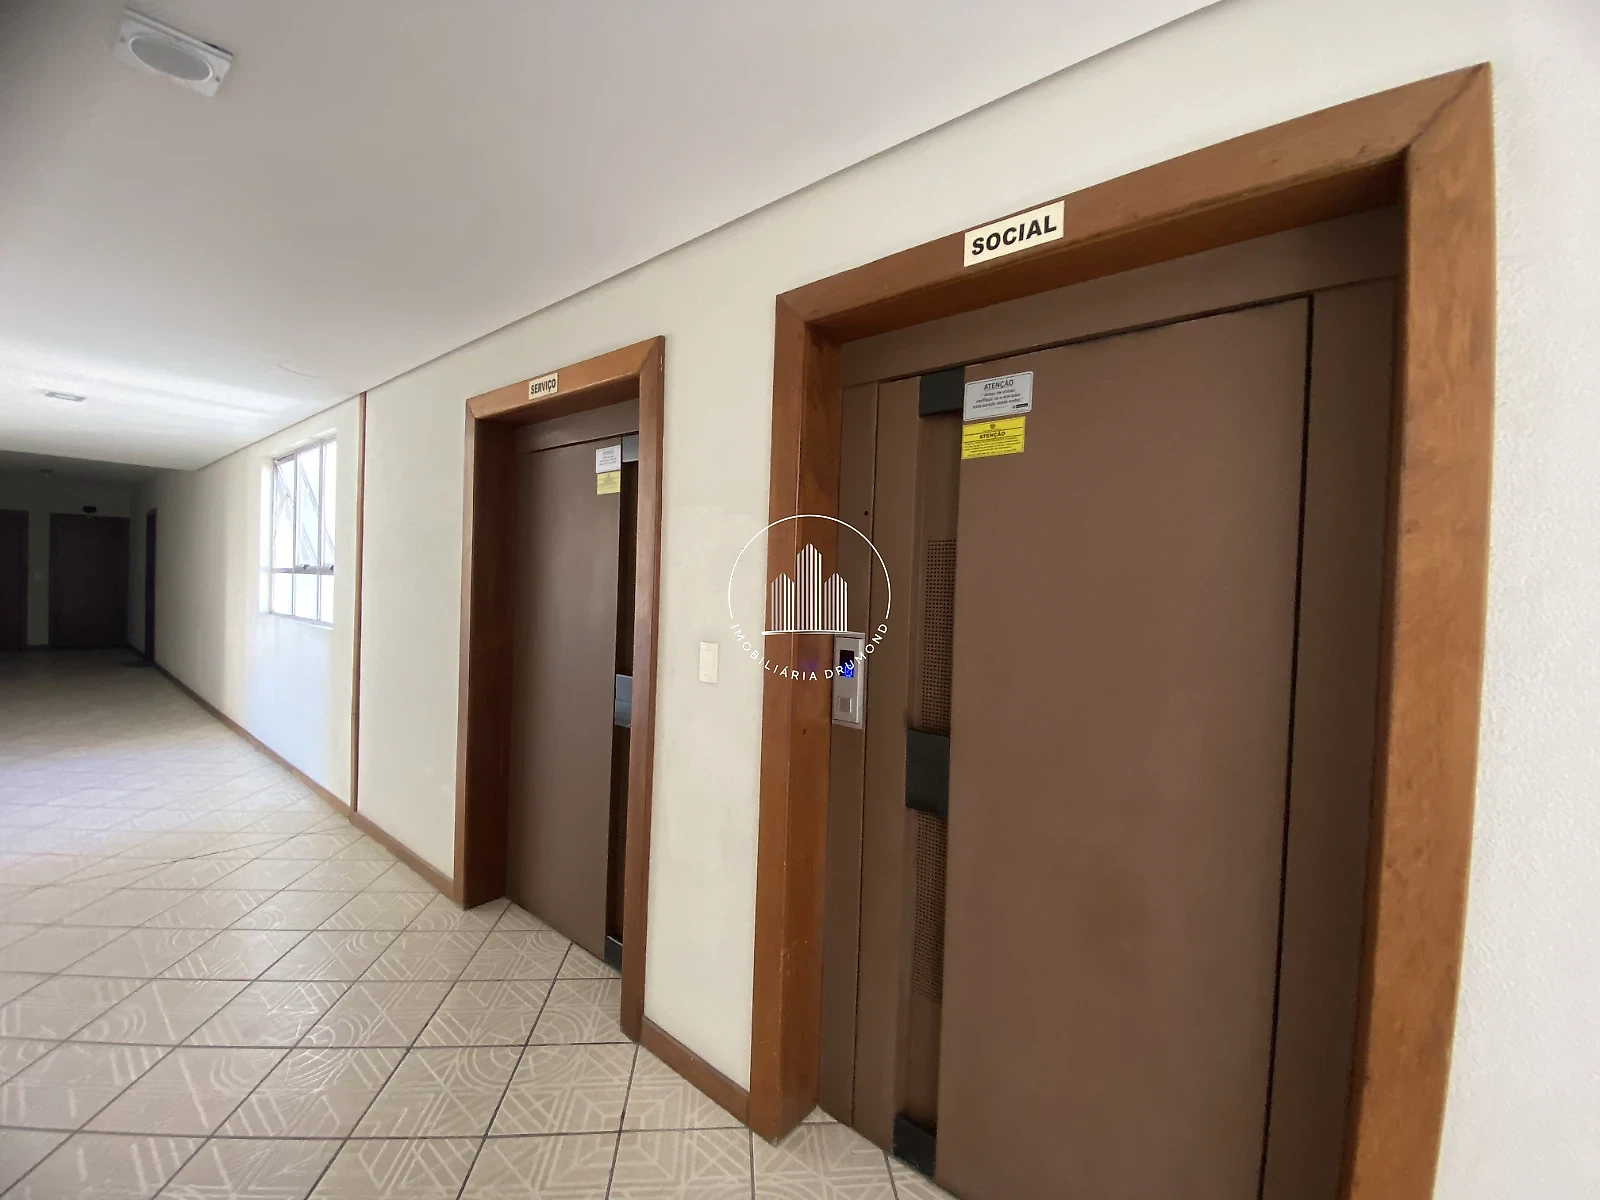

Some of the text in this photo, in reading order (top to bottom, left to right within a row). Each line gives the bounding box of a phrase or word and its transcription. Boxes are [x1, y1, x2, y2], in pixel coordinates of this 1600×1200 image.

[972, 215, 1057, 256] SOCIAL
[531, 378, 556, 394] SERVIÇO
[984, 379, 1014, 391] ATENÇÃO
[979, 431, 1006, 439] ATENÇÃO
